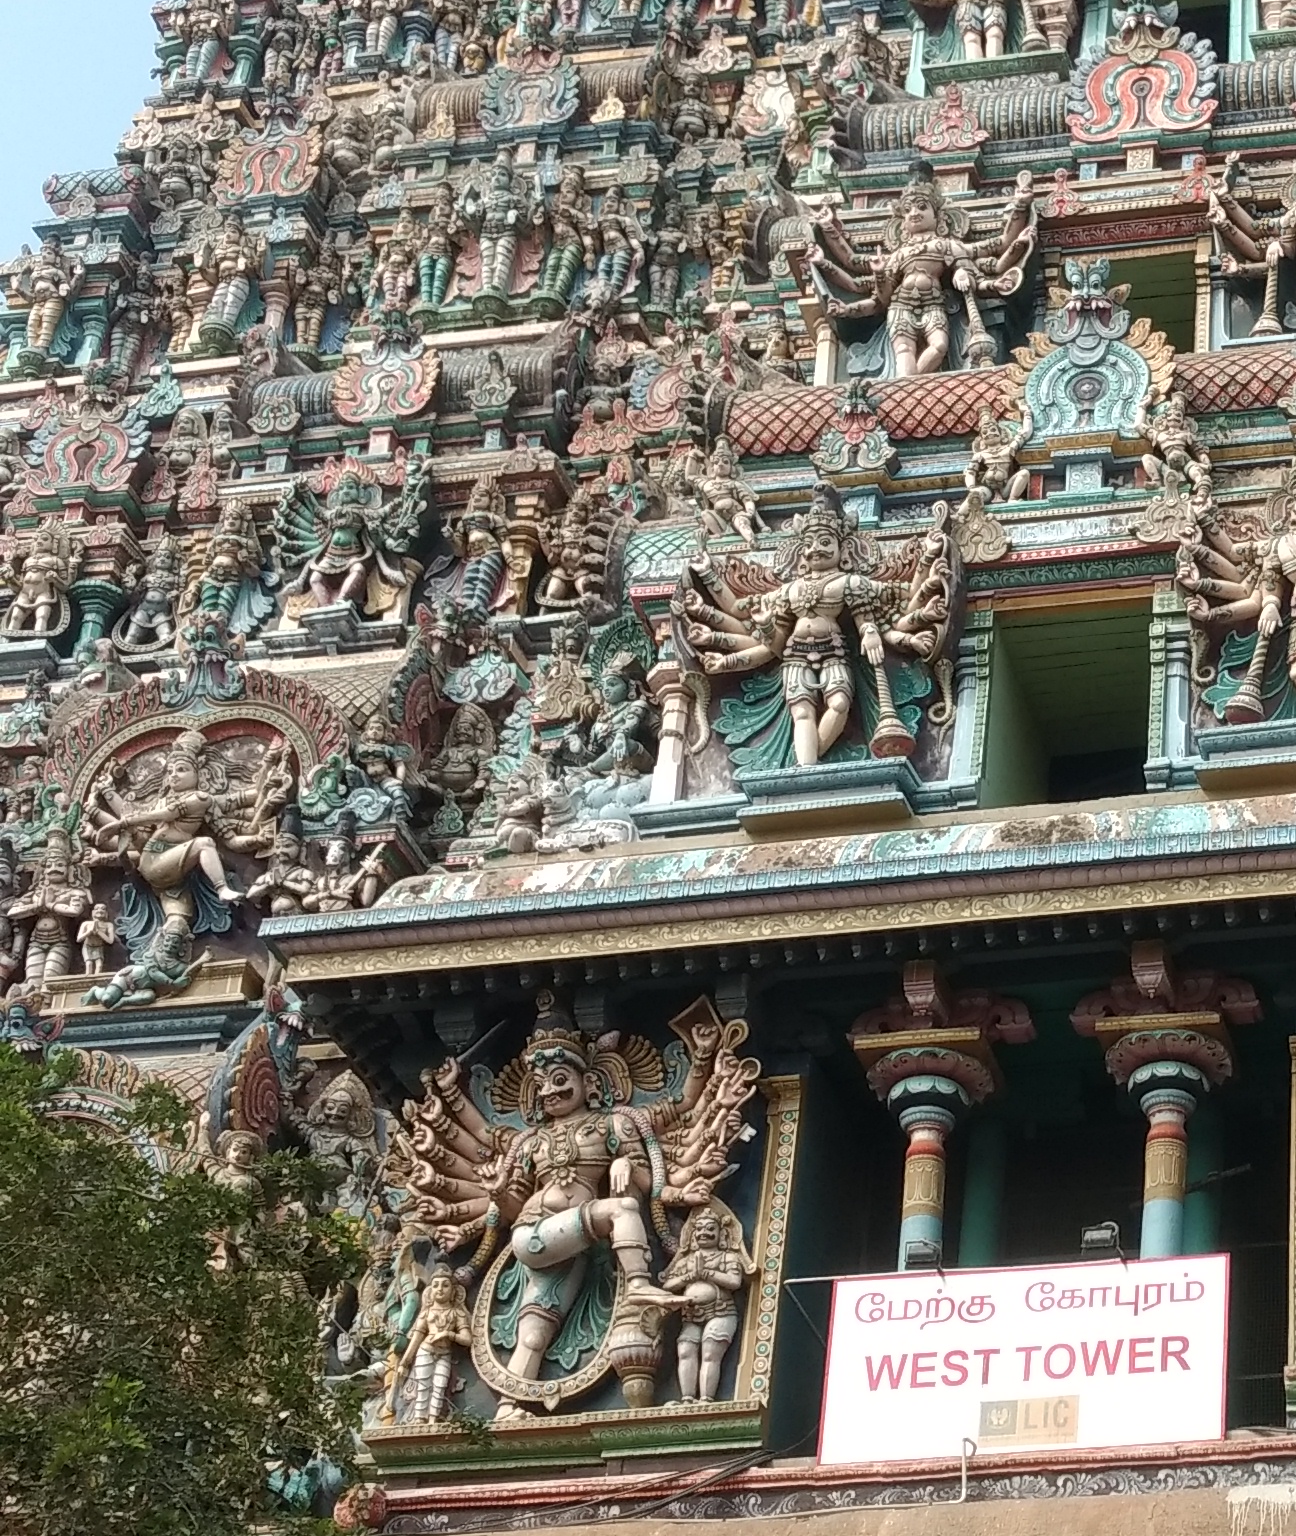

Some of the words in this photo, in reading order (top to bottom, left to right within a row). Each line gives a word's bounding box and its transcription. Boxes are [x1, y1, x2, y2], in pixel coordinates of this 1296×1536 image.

[854, 1288, 996, 1330] மேற்கு
[1024, 1272, 1205, 1316] கோபுரம்
[864, 1348, 1001, 1392] WEST
[1015, 1335, 1191, 1382] TOWER
[1023, 1399, 1070, 1430] LIC
